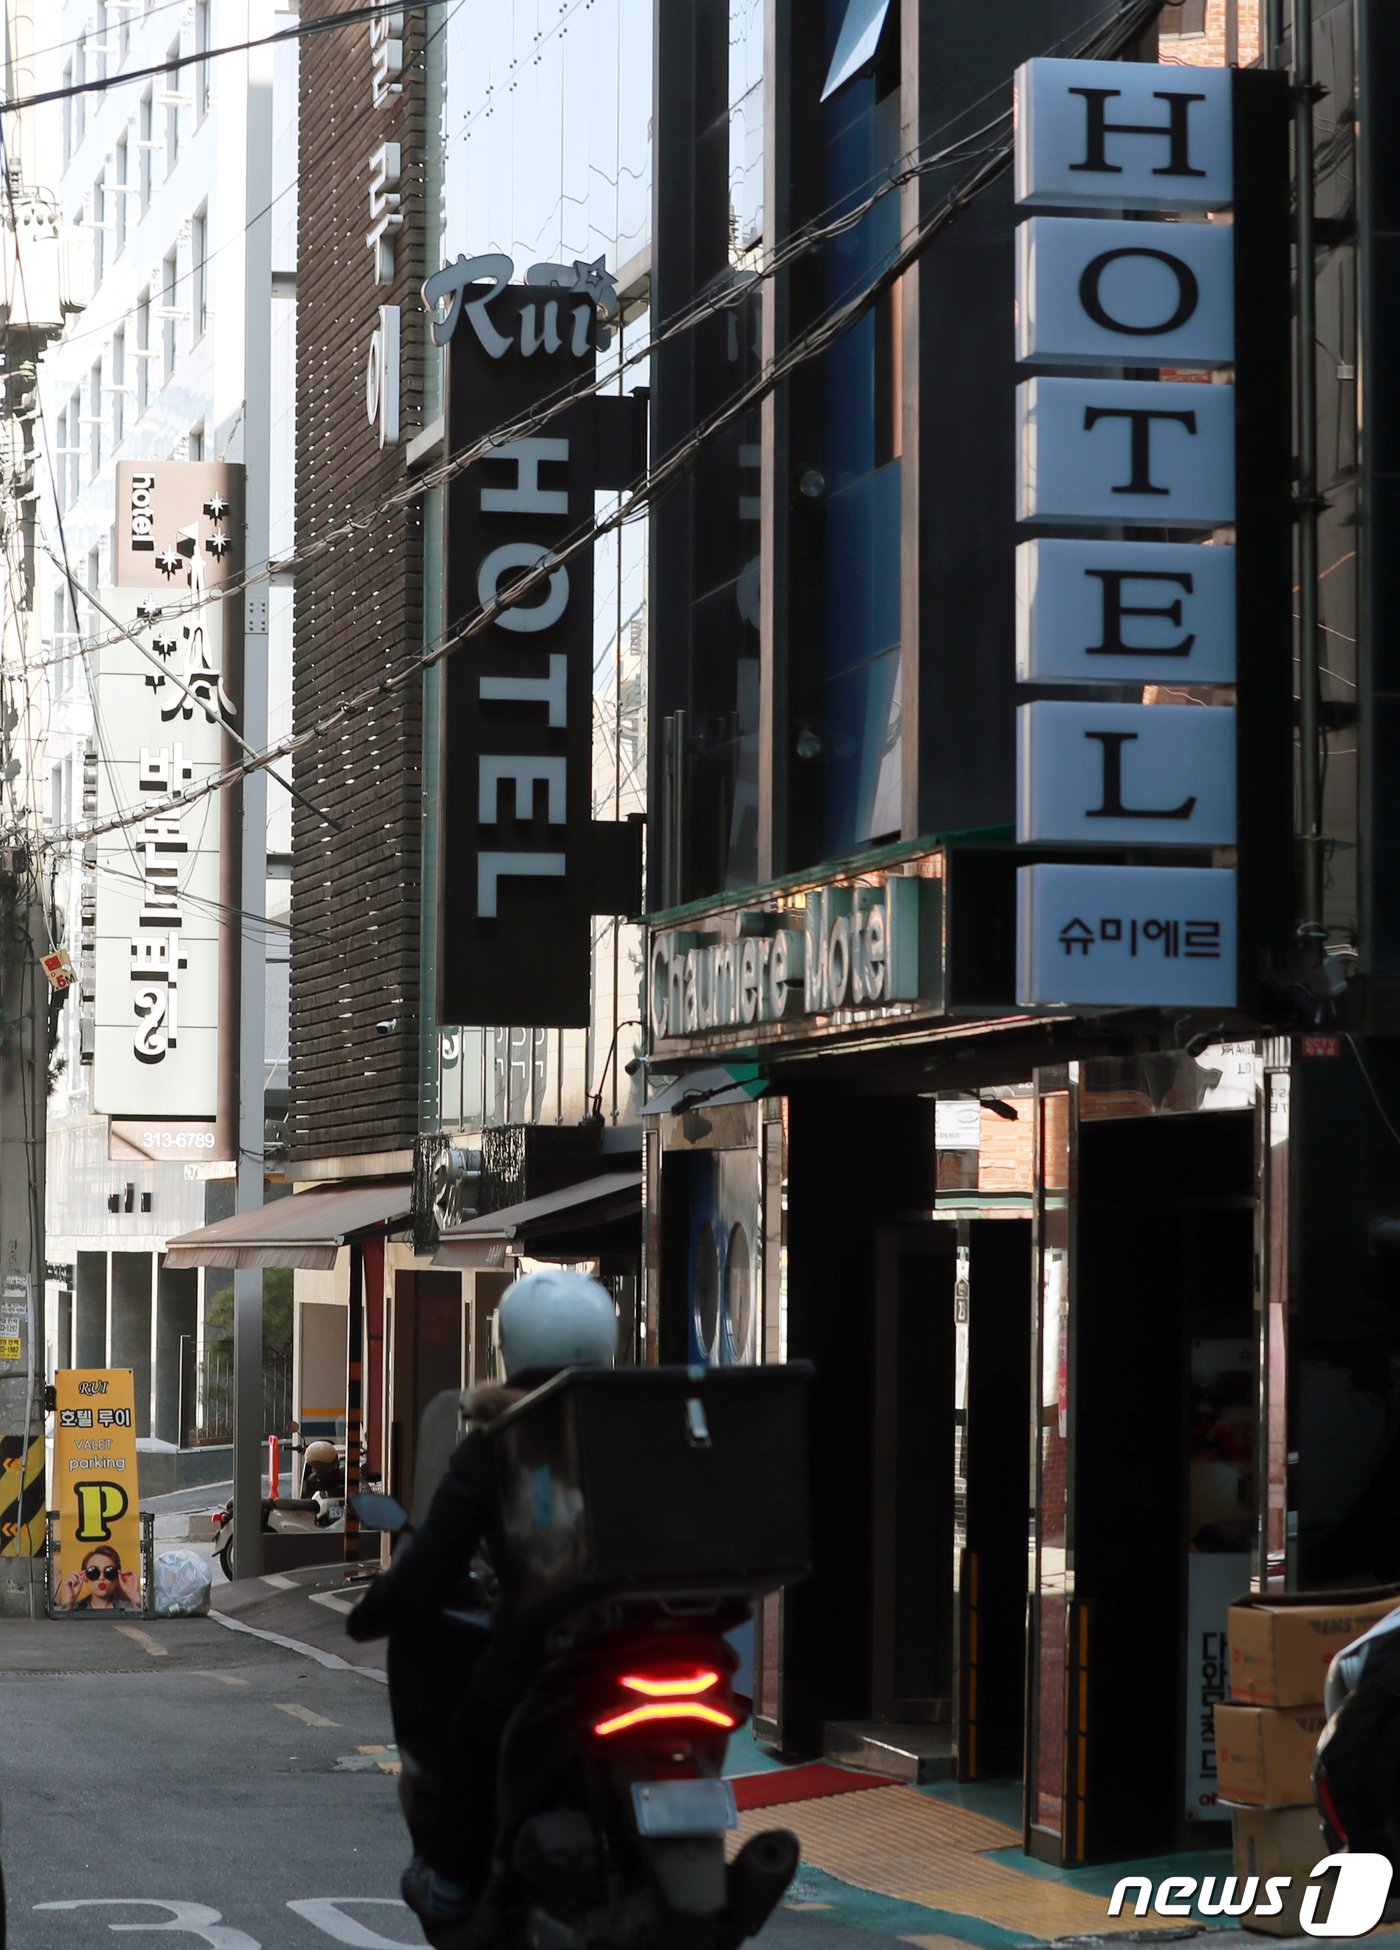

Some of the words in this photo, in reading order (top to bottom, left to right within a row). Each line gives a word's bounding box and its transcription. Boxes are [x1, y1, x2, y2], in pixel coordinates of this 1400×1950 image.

[421, 254, 612, 358] Rui
[1066, 86, 1207, 820] HOTEL
[131, 472, 156, 550] hotel
[477, 437, 569, 918] HOTEL
[804, 876, 899, 1013] Motel
[1059, 917, 1221, 957] 슈미에르
[142, 1131, 216, 1149] 313-6789
[78, 1380, 109, 1396] RUI
[60, 1409, 93, 1429] 호텔
[98, 1408, 131, 1428] 루이
[68, 1455, 126, 1472] parking
[73, 1439, 114, 1450] VALET
[74, 1481, 129, 1542] P
